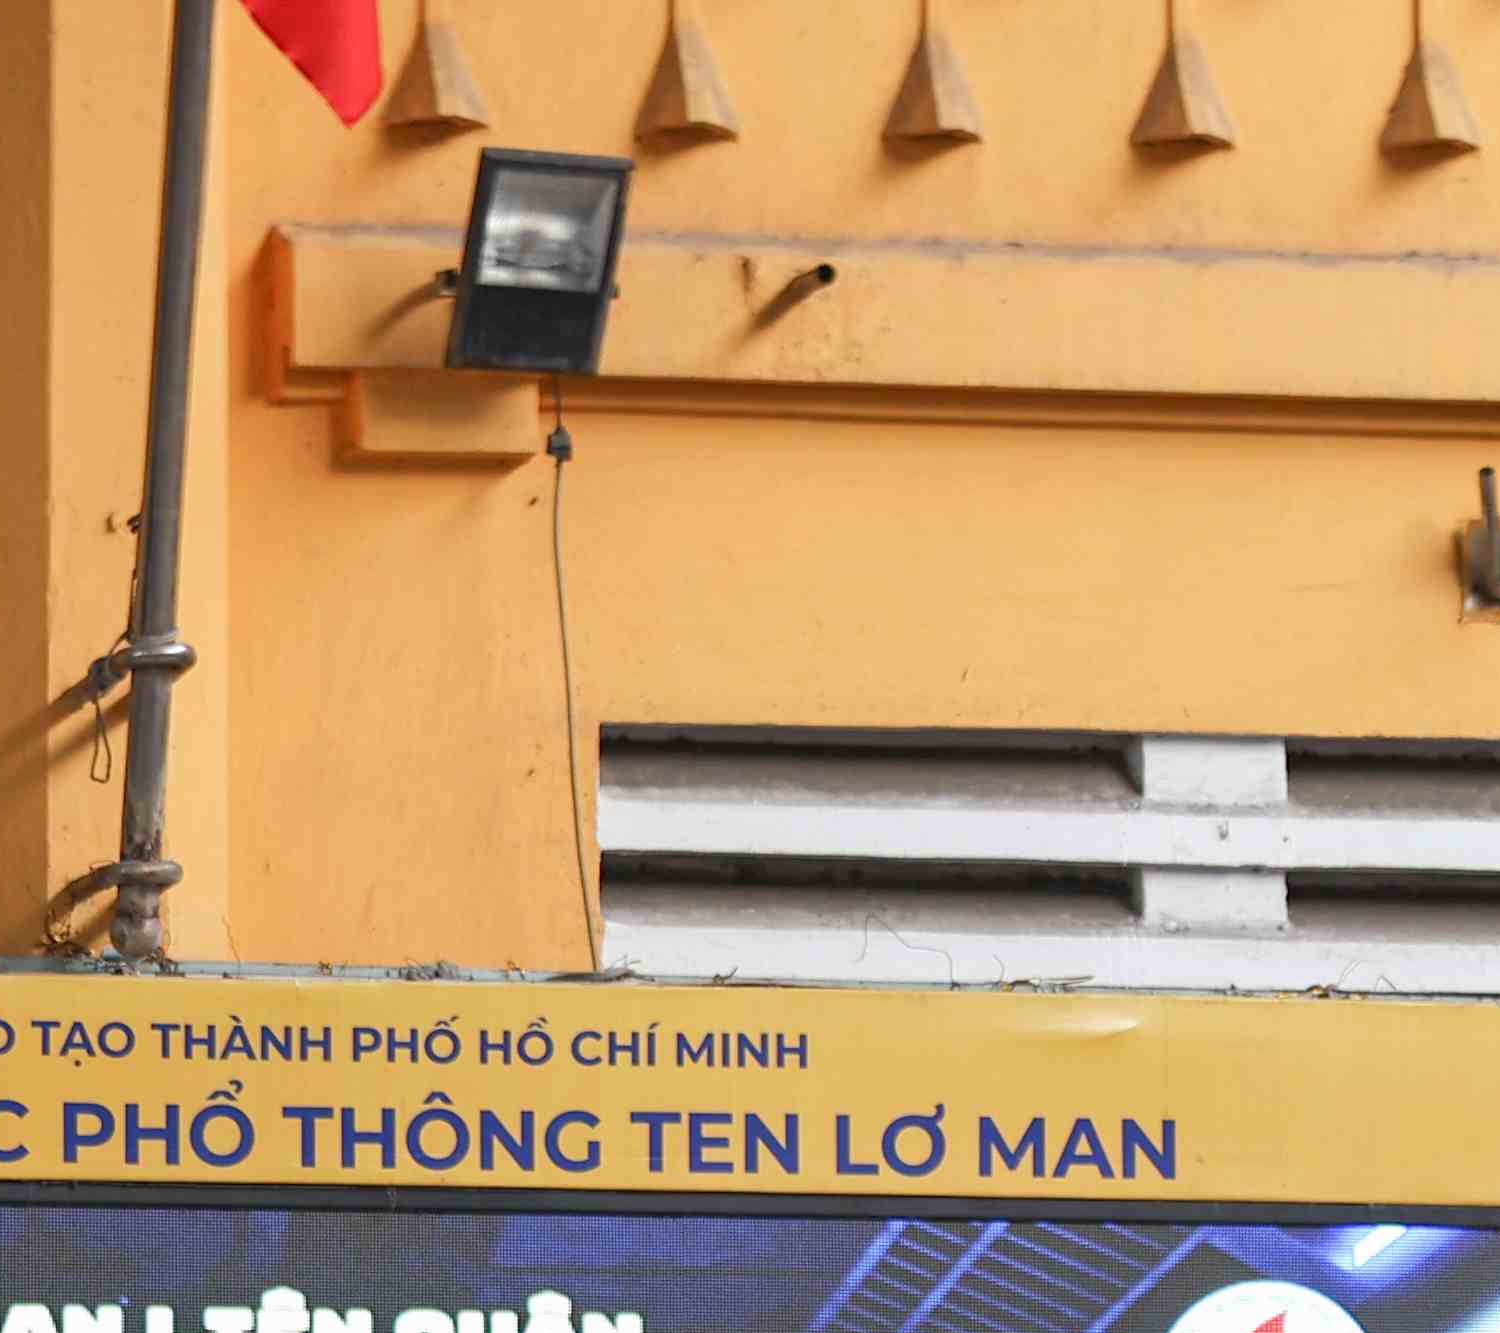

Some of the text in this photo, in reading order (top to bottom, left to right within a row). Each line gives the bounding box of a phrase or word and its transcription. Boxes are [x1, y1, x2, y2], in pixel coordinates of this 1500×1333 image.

[32, 1020, 136, 1066] TẠO
[151, 1015, 333, 1061] THÀNH
[352, 1016, 463, 1064] PHỐ
[479, 1017, 555, 1066] HỒ
[571, 1022, 658, 1067] CHÍ
[675, 1032, 810, 1068] MINH
[62, 1080, 256, 1167] PHỔ
[282, 1091, 602, 1173] THÔNG
[630, 1111, 800, 1174] TEN
[835, 1103, 946, 1177] LƠ
[978, 1116, 1176, 1180] MAN
